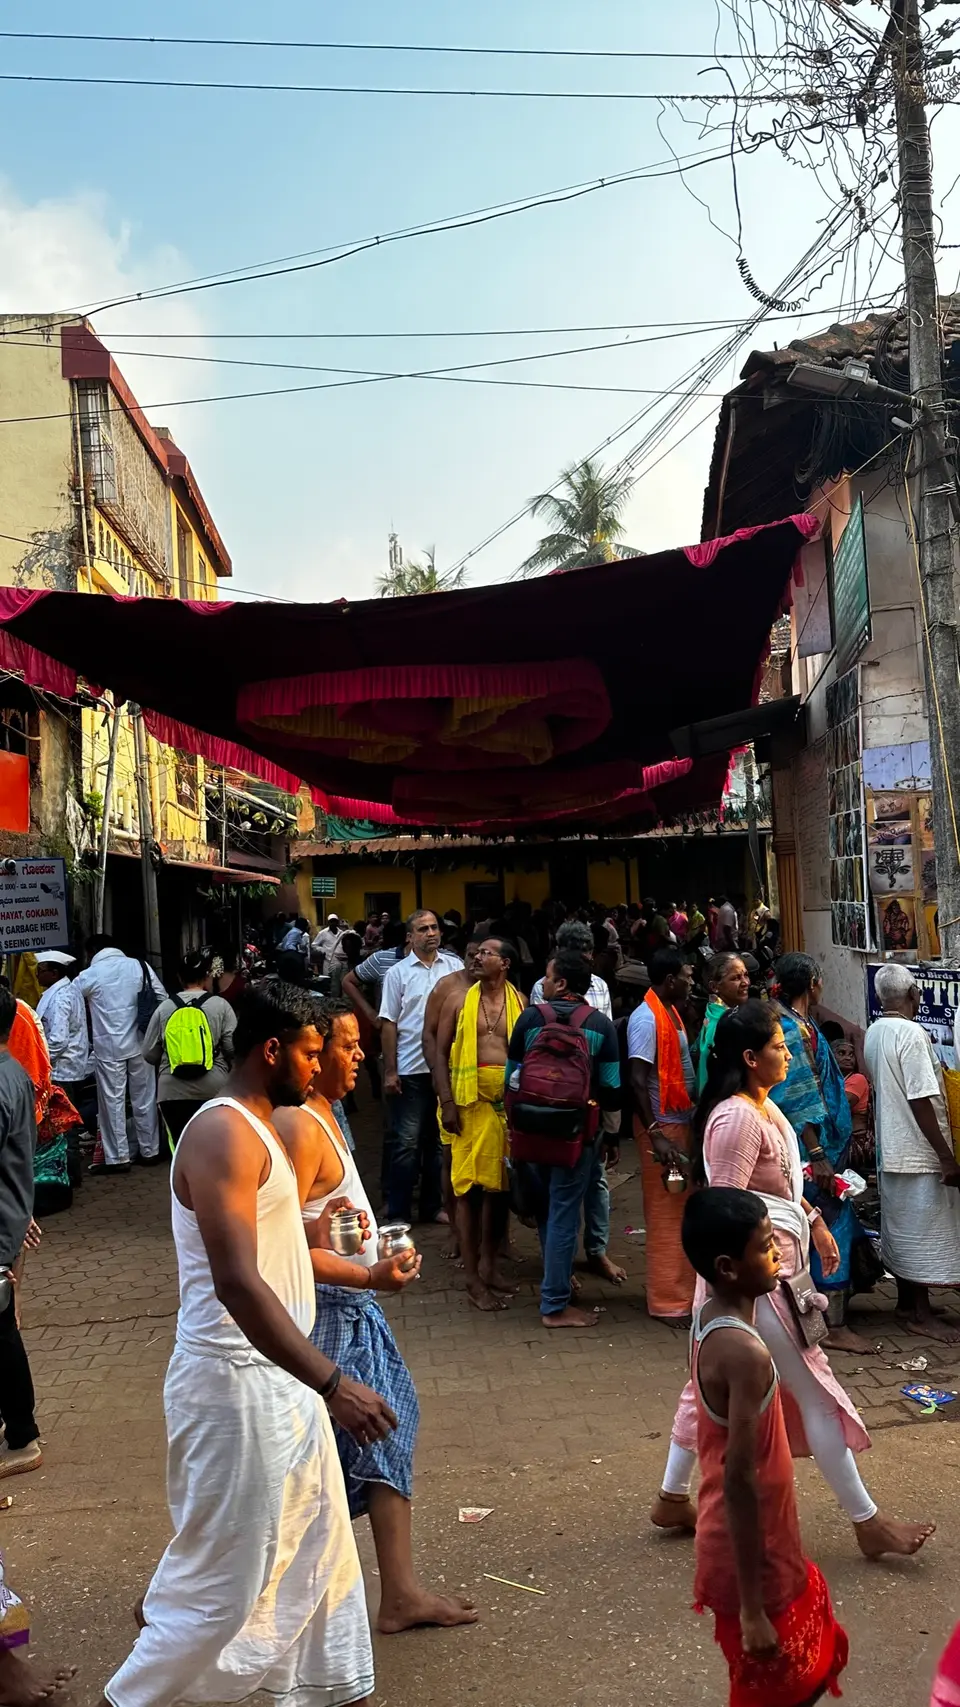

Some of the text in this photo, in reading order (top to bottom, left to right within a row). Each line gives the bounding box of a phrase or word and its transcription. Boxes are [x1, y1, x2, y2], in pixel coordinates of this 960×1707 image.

[0, 907, 59, 920] HAYAT, GOKARNA
[6, 923, 39, 934] GARBAGE
[40, 921, 60, 931] HERE,
[4, 938, 30, 948] SEEING
[31, 936, 46, 946] YOU
[927, 971, 953, 979] Birds
